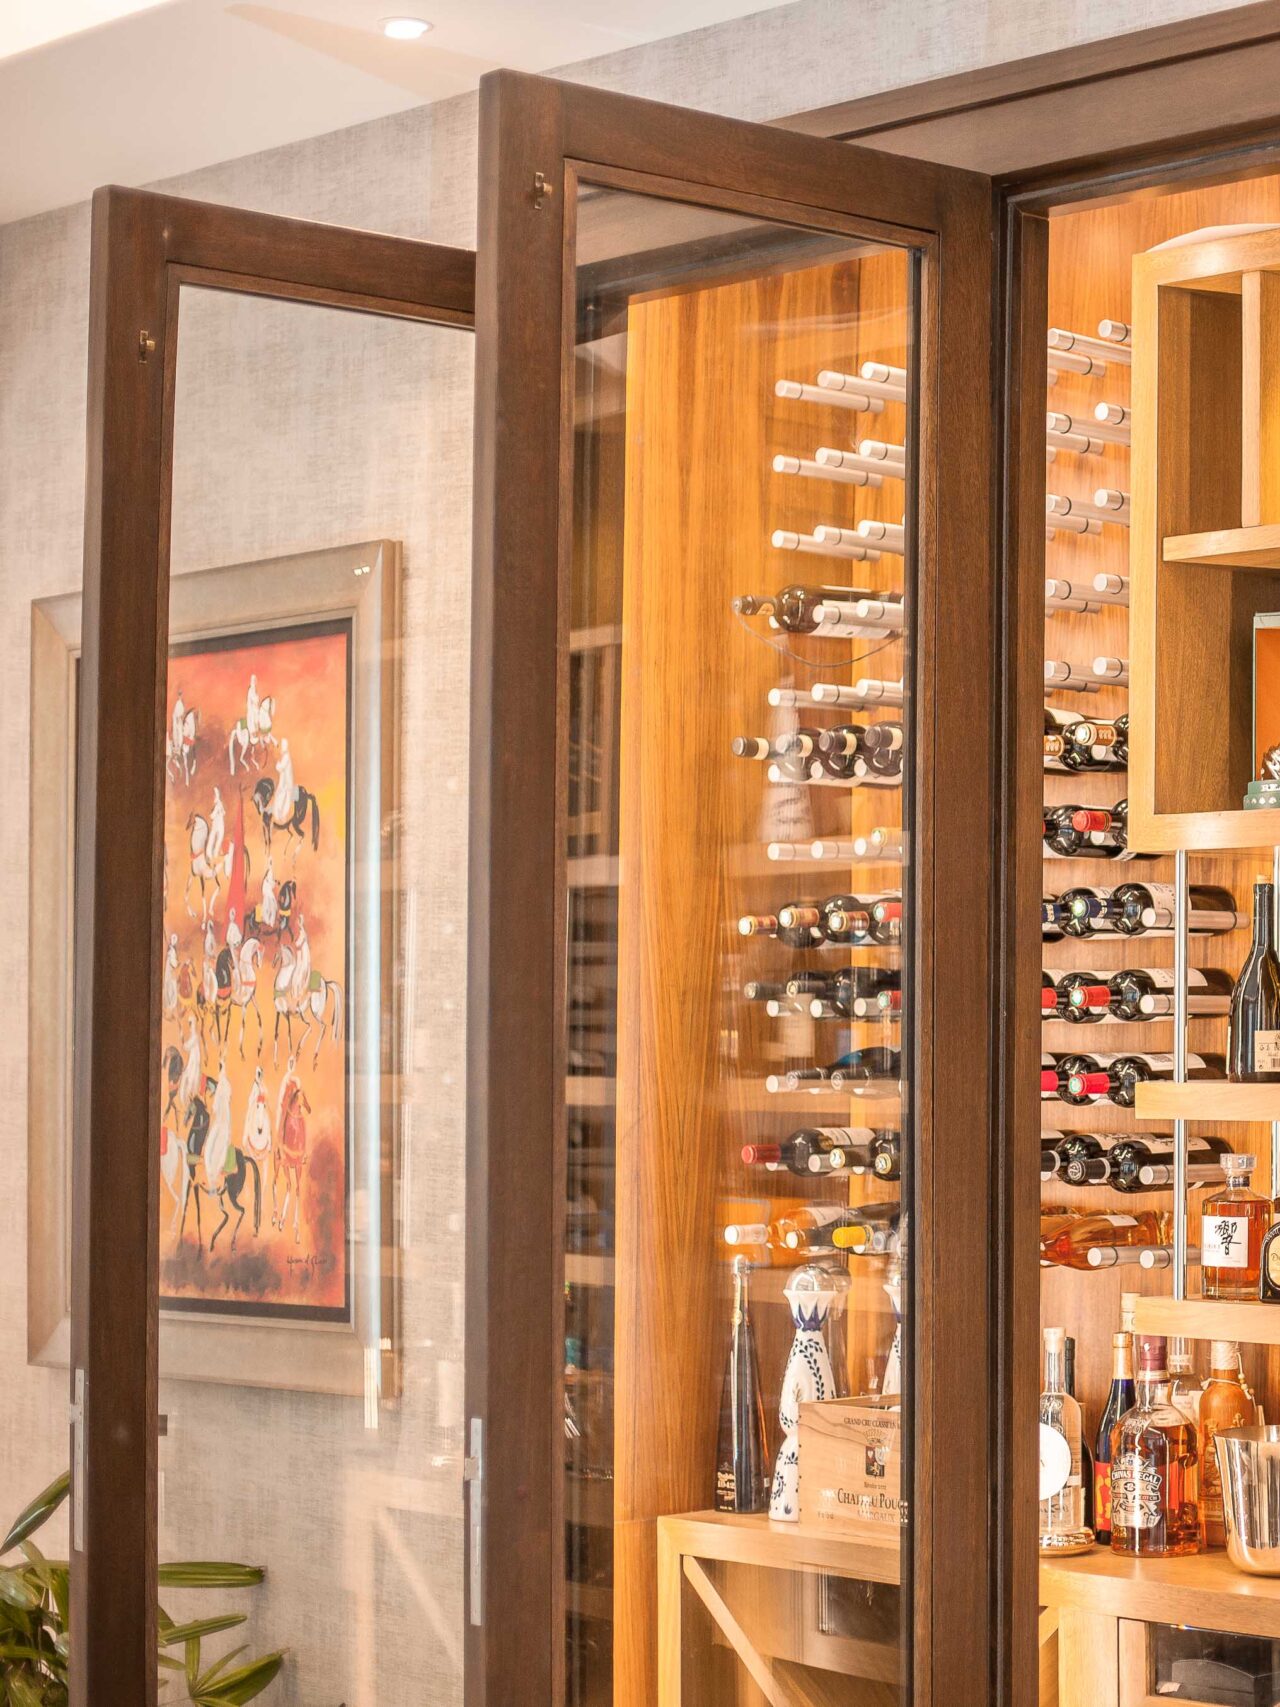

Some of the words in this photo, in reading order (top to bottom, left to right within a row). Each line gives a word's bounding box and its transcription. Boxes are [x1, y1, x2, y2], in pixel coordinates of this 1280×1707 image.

[1112, 1470, 1131, 1481] CHIVAS
[1134, 1470, 1159, 1485] EGAL
[837, 1487, 877, 1507] CHATU
